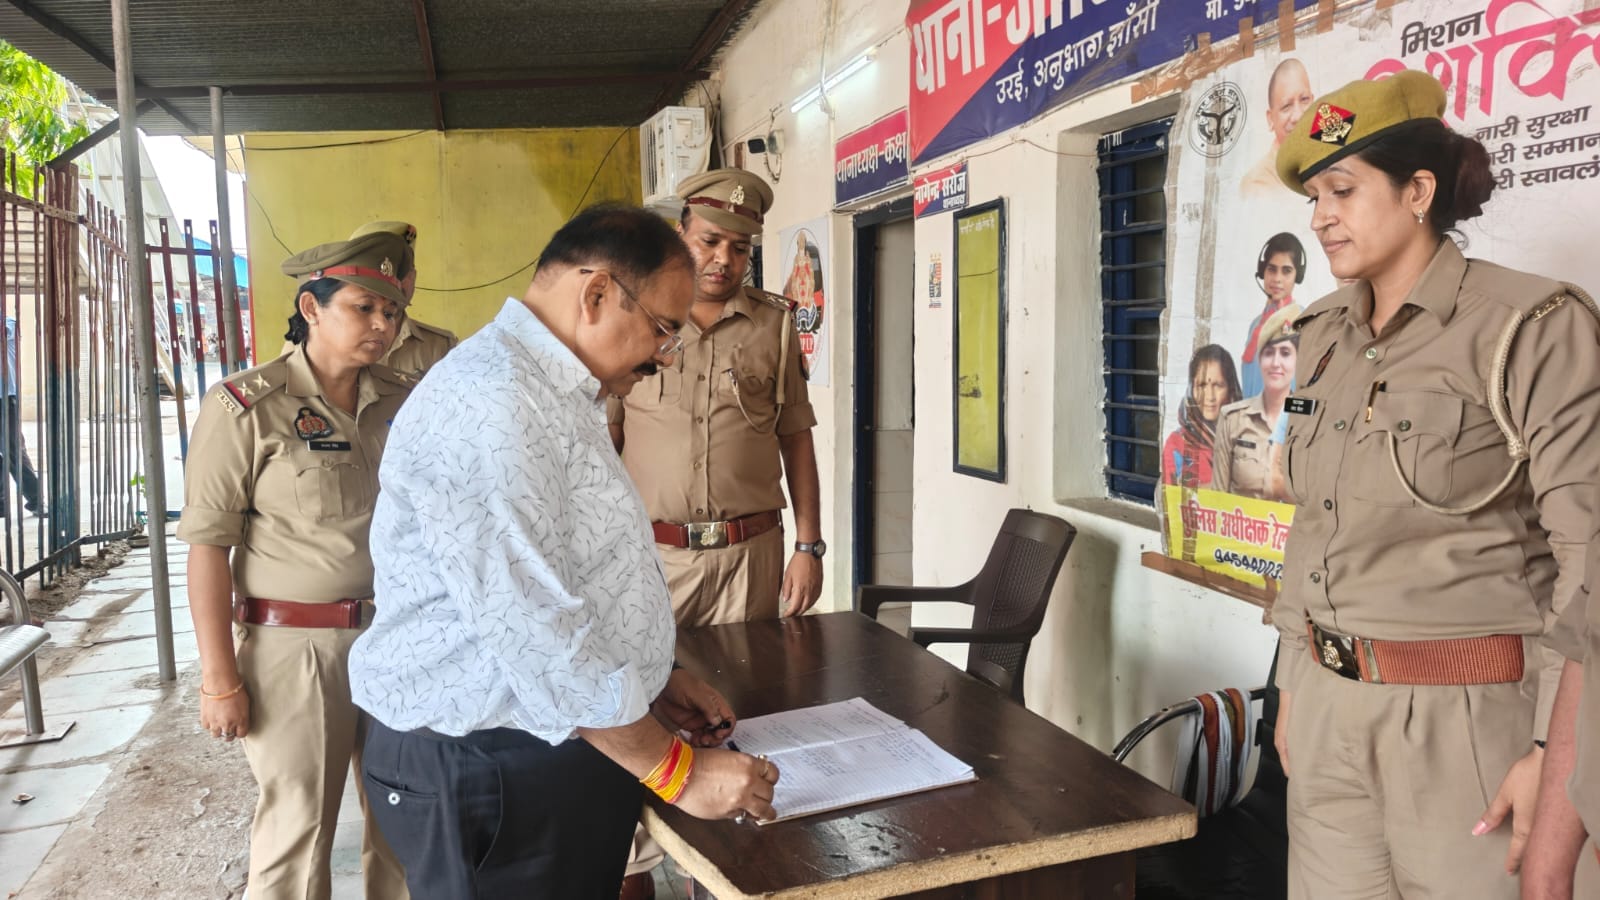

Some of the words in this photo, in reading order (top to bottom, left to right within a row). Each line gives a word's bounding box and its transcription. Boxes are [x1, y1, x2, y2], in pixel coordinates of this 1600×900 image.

[1401, 10, 1485, 57] मिशन
[995, 57, 1029, 104] उरई,
[1033, 30, 1103, 91] अनुभाग
[1525, 105, 1592, 139] सुरक्षा
[836, 131, 907, 185] थानाध्यक्ष-कक्ष
[1488, 142, 1517, 166] ारी
[1179, 501, 1217, 537] पुलिस
[1214, 548, 1284, 580] 94544003
